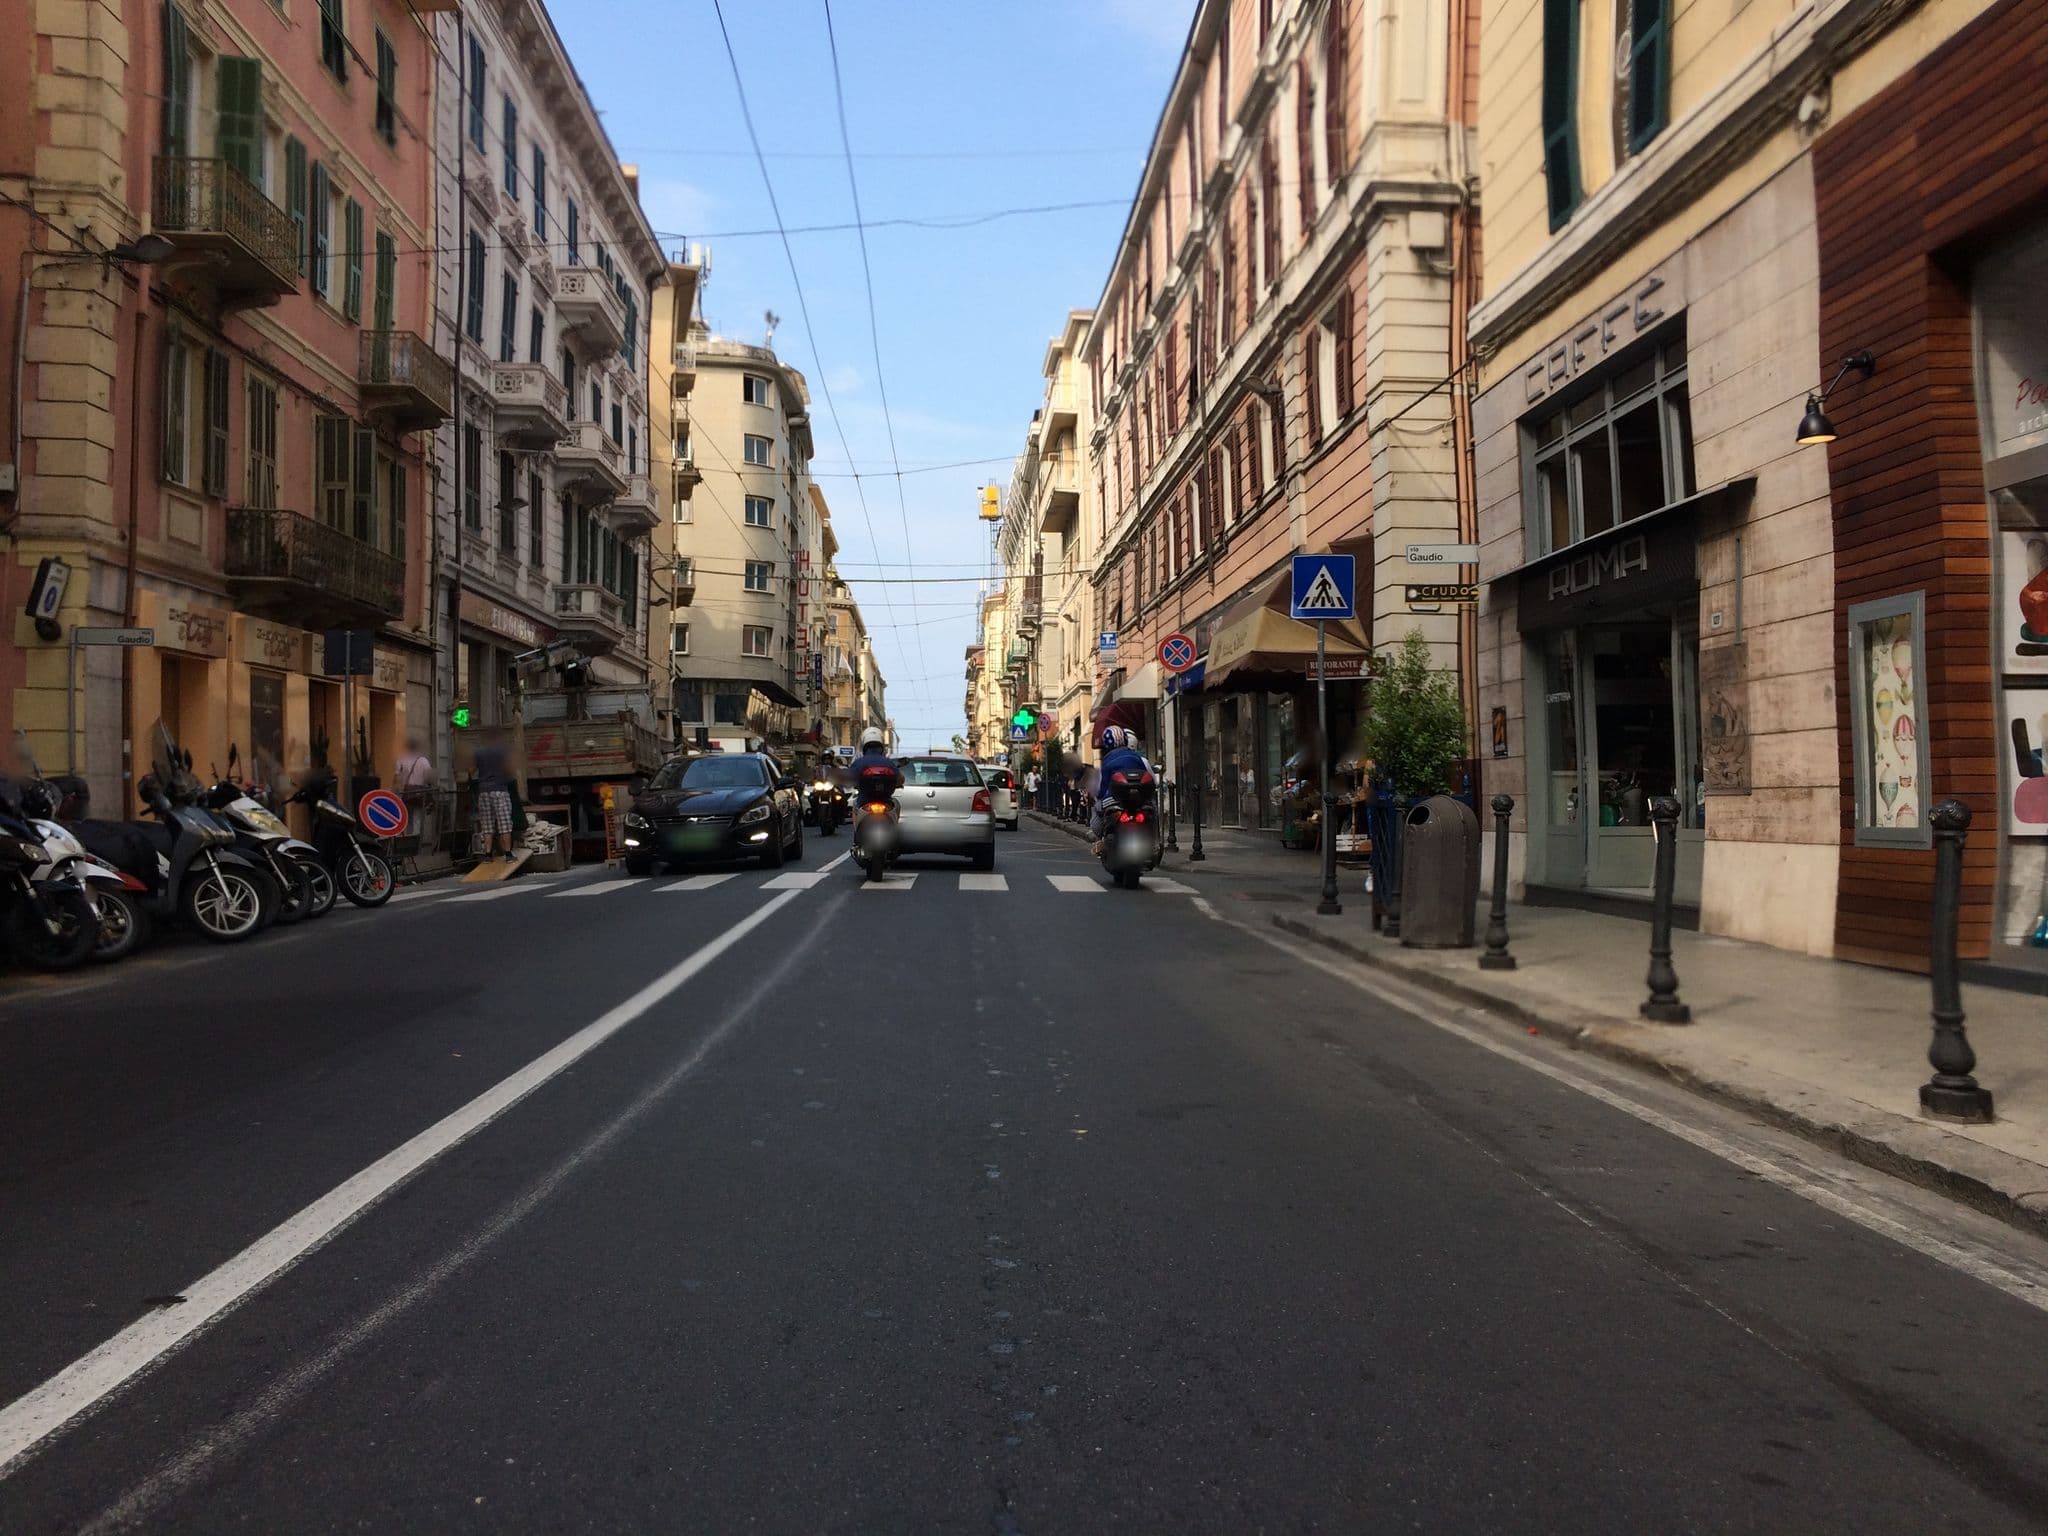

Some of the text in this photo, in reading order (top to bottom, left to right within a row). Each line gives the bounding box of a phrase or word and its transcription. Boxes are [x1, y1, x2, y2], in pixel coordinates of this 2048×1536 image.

[1409, 553, 1443, 561] Gaudio
[1548, 535, 1648, 600] ROMA
[796, 550, 810, 674] HOTEL
[117, 635, 150, 643] Gaudio
[1310, 660, 1359, 669] RITORANTE
